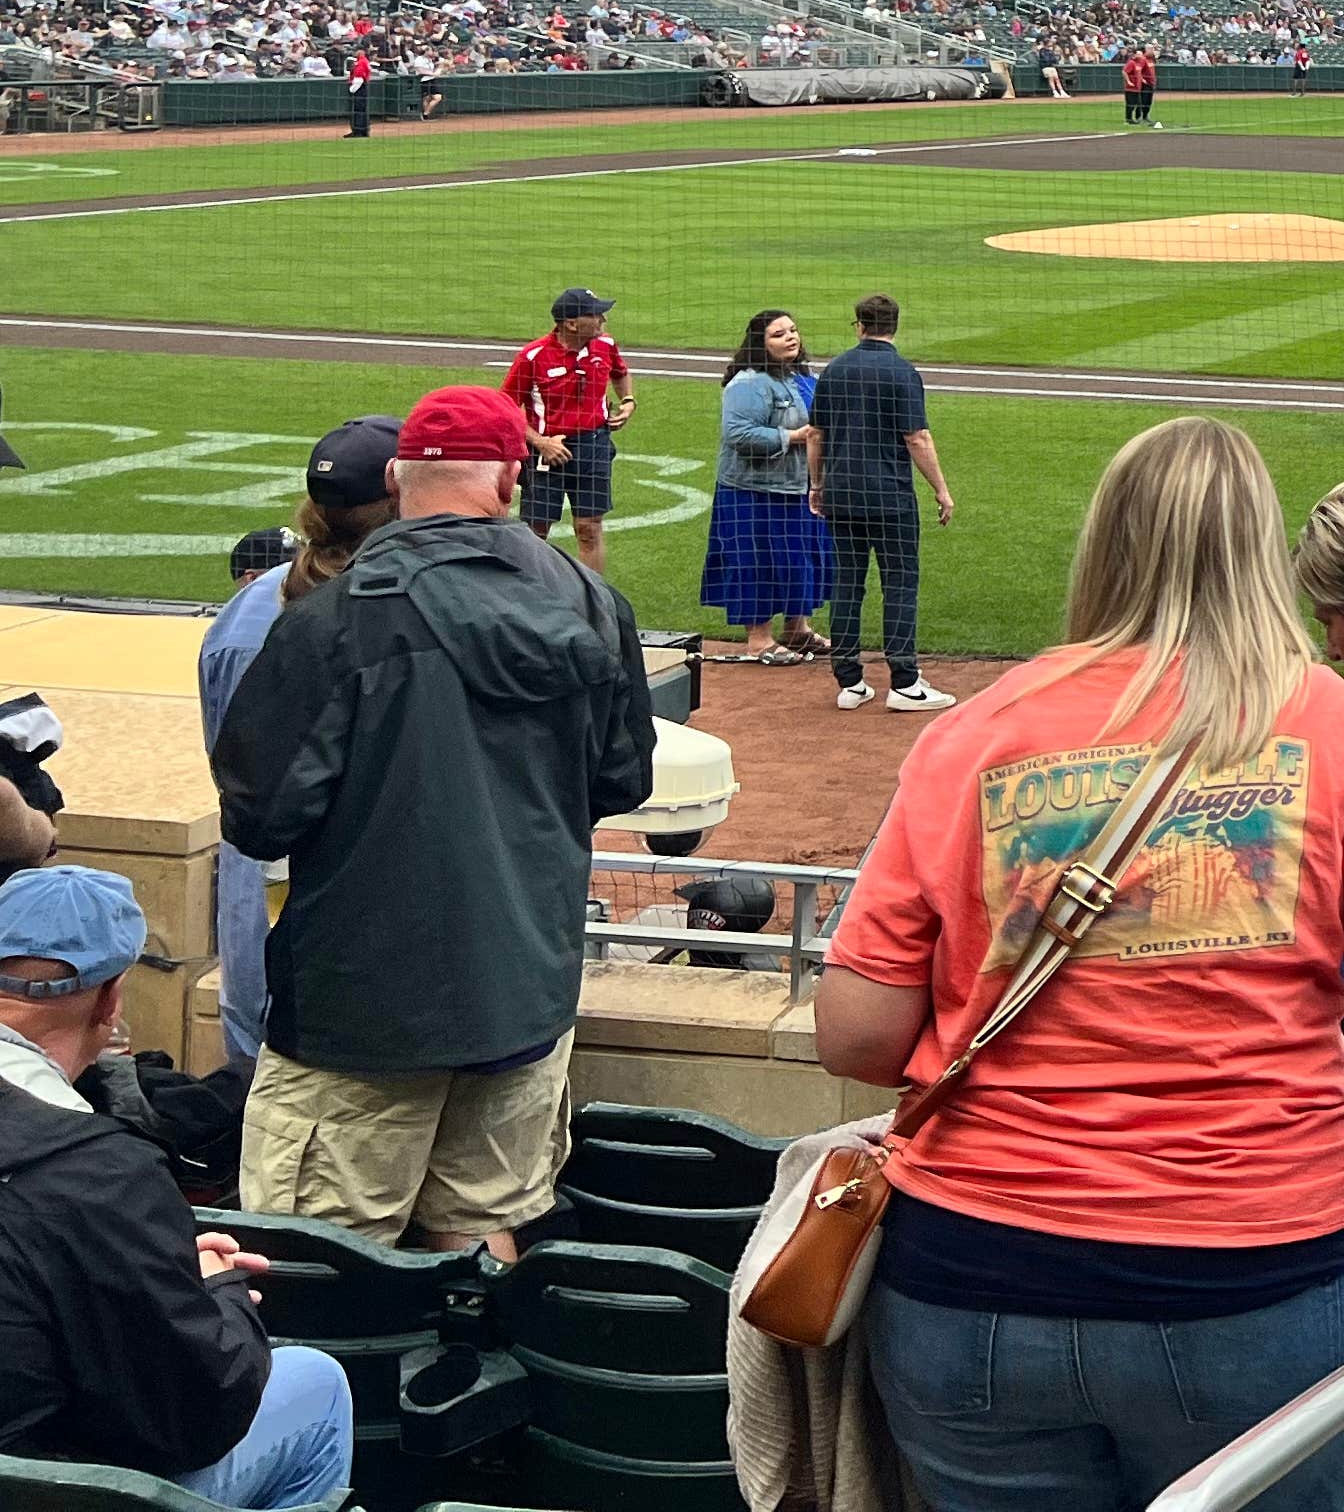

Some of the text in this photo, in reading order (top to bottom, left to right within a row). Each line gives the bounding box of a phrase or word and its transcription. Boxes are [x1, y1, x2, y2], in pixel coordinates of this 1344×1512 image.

[985, 752, 1062, 782] AMERICAN
[1164, 785, 1296, 822] Slugger
[1125, 931, 1293, 956] LOUISVILLE KY
